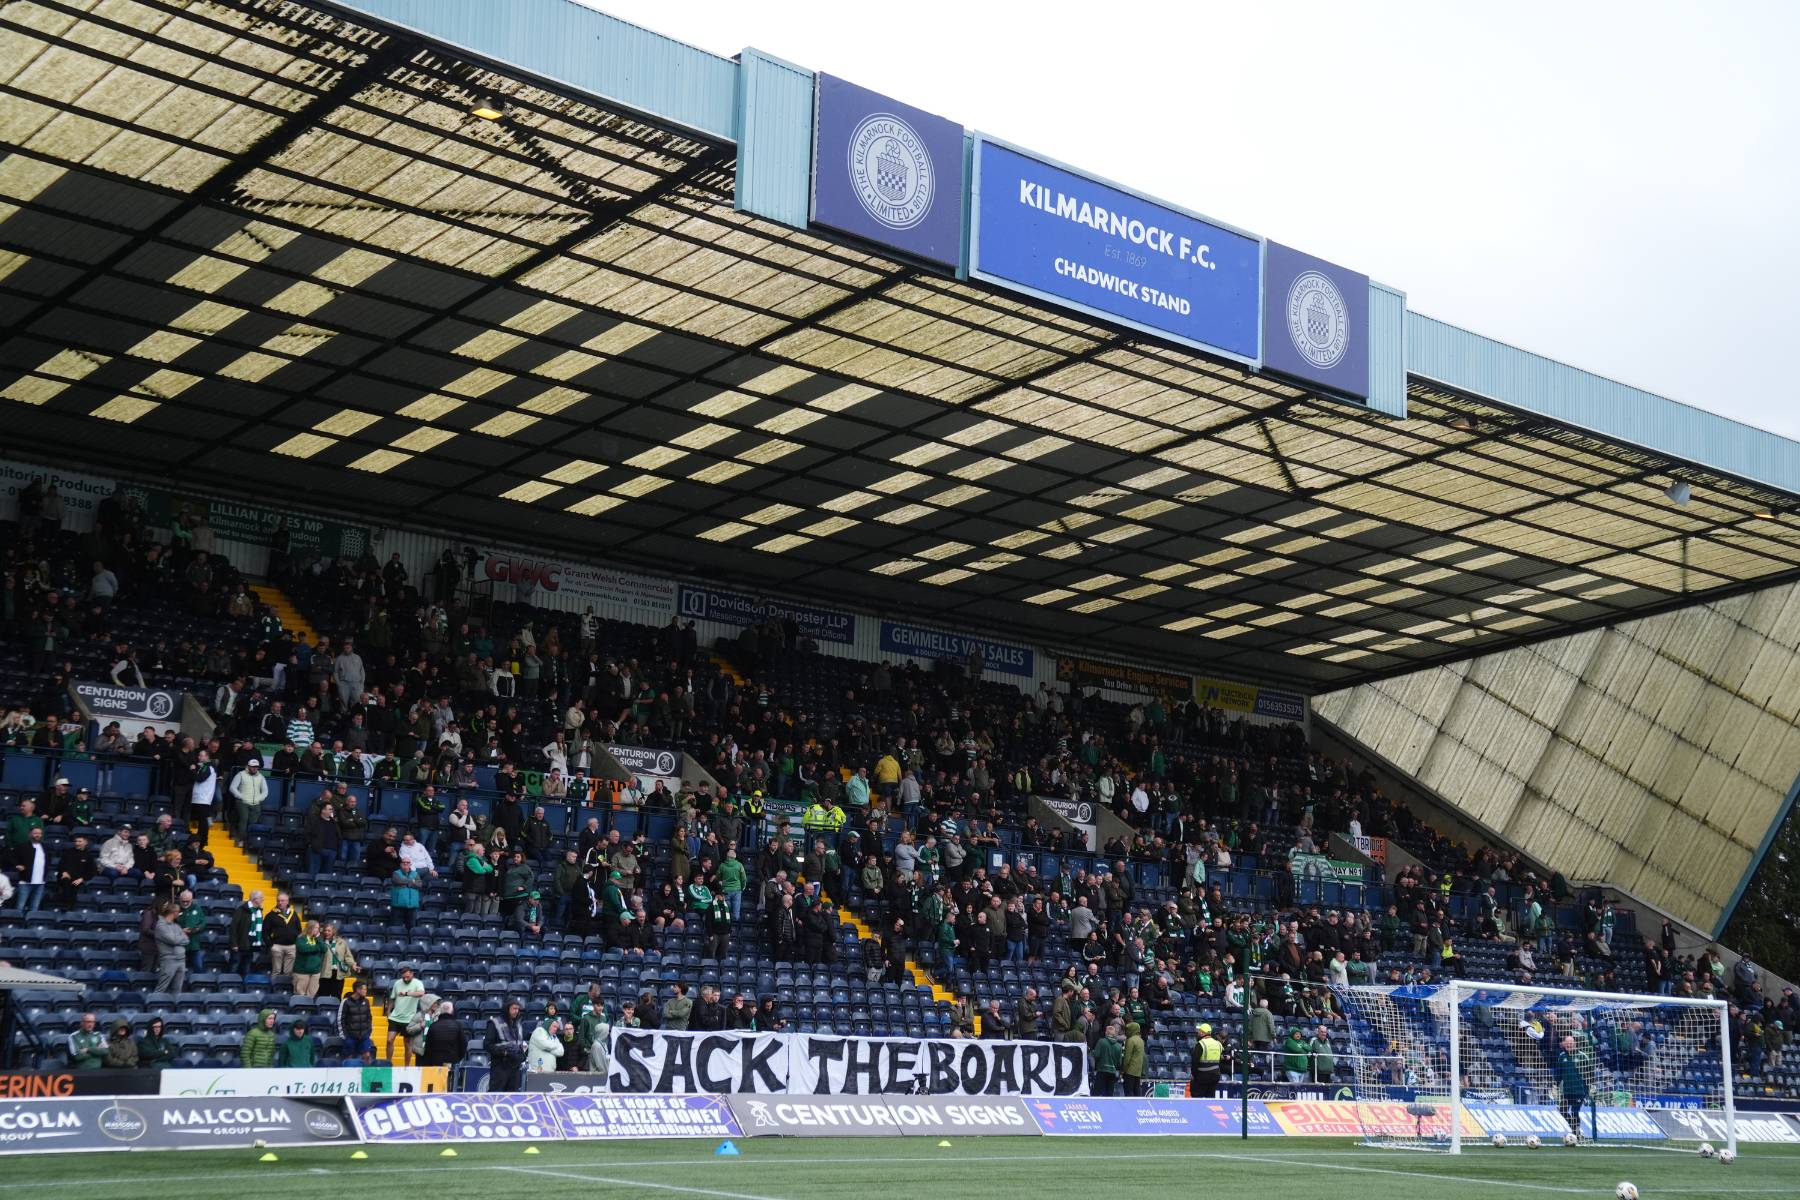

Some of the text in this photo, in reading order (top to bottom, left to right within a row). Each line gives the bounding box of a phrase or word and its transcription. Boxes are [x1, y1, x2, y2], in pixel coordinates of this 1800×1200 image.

[856, 123, 928, 210] THE KILMARNOCK FOOTBALL CLUB
[870, 195, 910, 221] LIMITED
[1019, 178, 1216, 270] KILMARNOCK F.C.
[1126, 250, 1147, 270] 1869
[1054, 257, 1191, 316] CHADWICK STAND
[1292, 280, 1320, 316] KILMARNOCK
[1303, 342, 1332, 361] LIMITED
[51, 474, 112, 496] Products
[210, 502, 258, 521] LILLIAN
[304, 520, 324, 532] MP
[485, 553, 562, 592] GWC
[564, 567, 673, 595] Grant Welsh Commercials
[710, 594, 766, 616] Davidson
[827, 615, 849, 629] LLP
[891, 627, 959, 654] GEMMELLS
[962, 639, 986, 658] VAN
[988, 645, 1025, 666] SALES
[1104, 678, 1115, 688] You
[1116, 681, 1132, 690] Drive
[1127, 669, 1154, 683] Engine
[1156, 674, 1188, 689] Services
[76, 684, 146, 702] CENTURION
[92, 698, 128, 710] SIGNS
[608, 746, 656, 760] CENTURION
[620, 756, 644, 768] SIGNS
[1043, 800, 1078, 811] ENTURION
[608, 1032, 1084, 1095] SACK THE BOARD
[310, 1082, 344, 1094] 0141
[592, 1098, 688, 1110] THE HOME OF
[1280, 1104, 1360, 1124] BILLY
[162, 1107, 292, 1125] MALCOLM
[568, 1109, 723, 1124] BIG PRIZE MONEY
[776, 1104, 1025, 1126] CENTURION SIGNS
[1059, 1110, 1104, 1123] FREW
[1470, 1109, 1573, 1132] HAMILTON
[213, 1126, 251, 1135] GROUP
[575, 1124, 730, 1136] www.Club3000Bingo.com
[1298, 1124, 1353, 1134] SPECIAL
